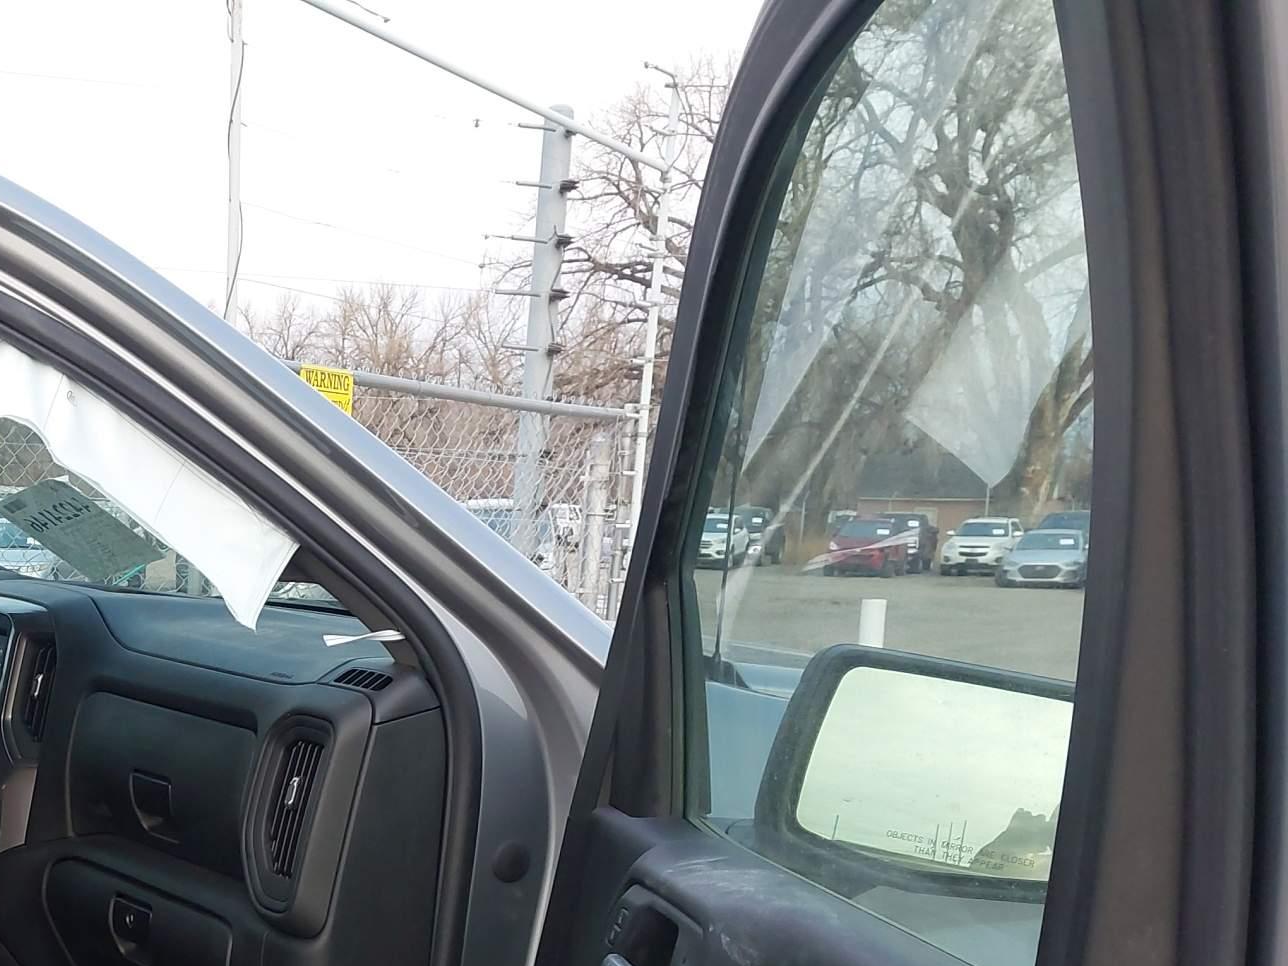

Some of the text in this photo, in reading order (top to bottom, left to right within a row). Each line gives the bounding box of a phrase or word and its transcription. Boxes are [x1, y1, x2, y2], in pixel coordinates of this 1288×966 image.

[305, 370, 350, 391] WARNING
[886, 829, 924, 844] OBJECTS
[927, 838, 937, 847] IN
[1000, 854, 1035, 867] CLOSER
[913, 845, 936, 857] THAN
